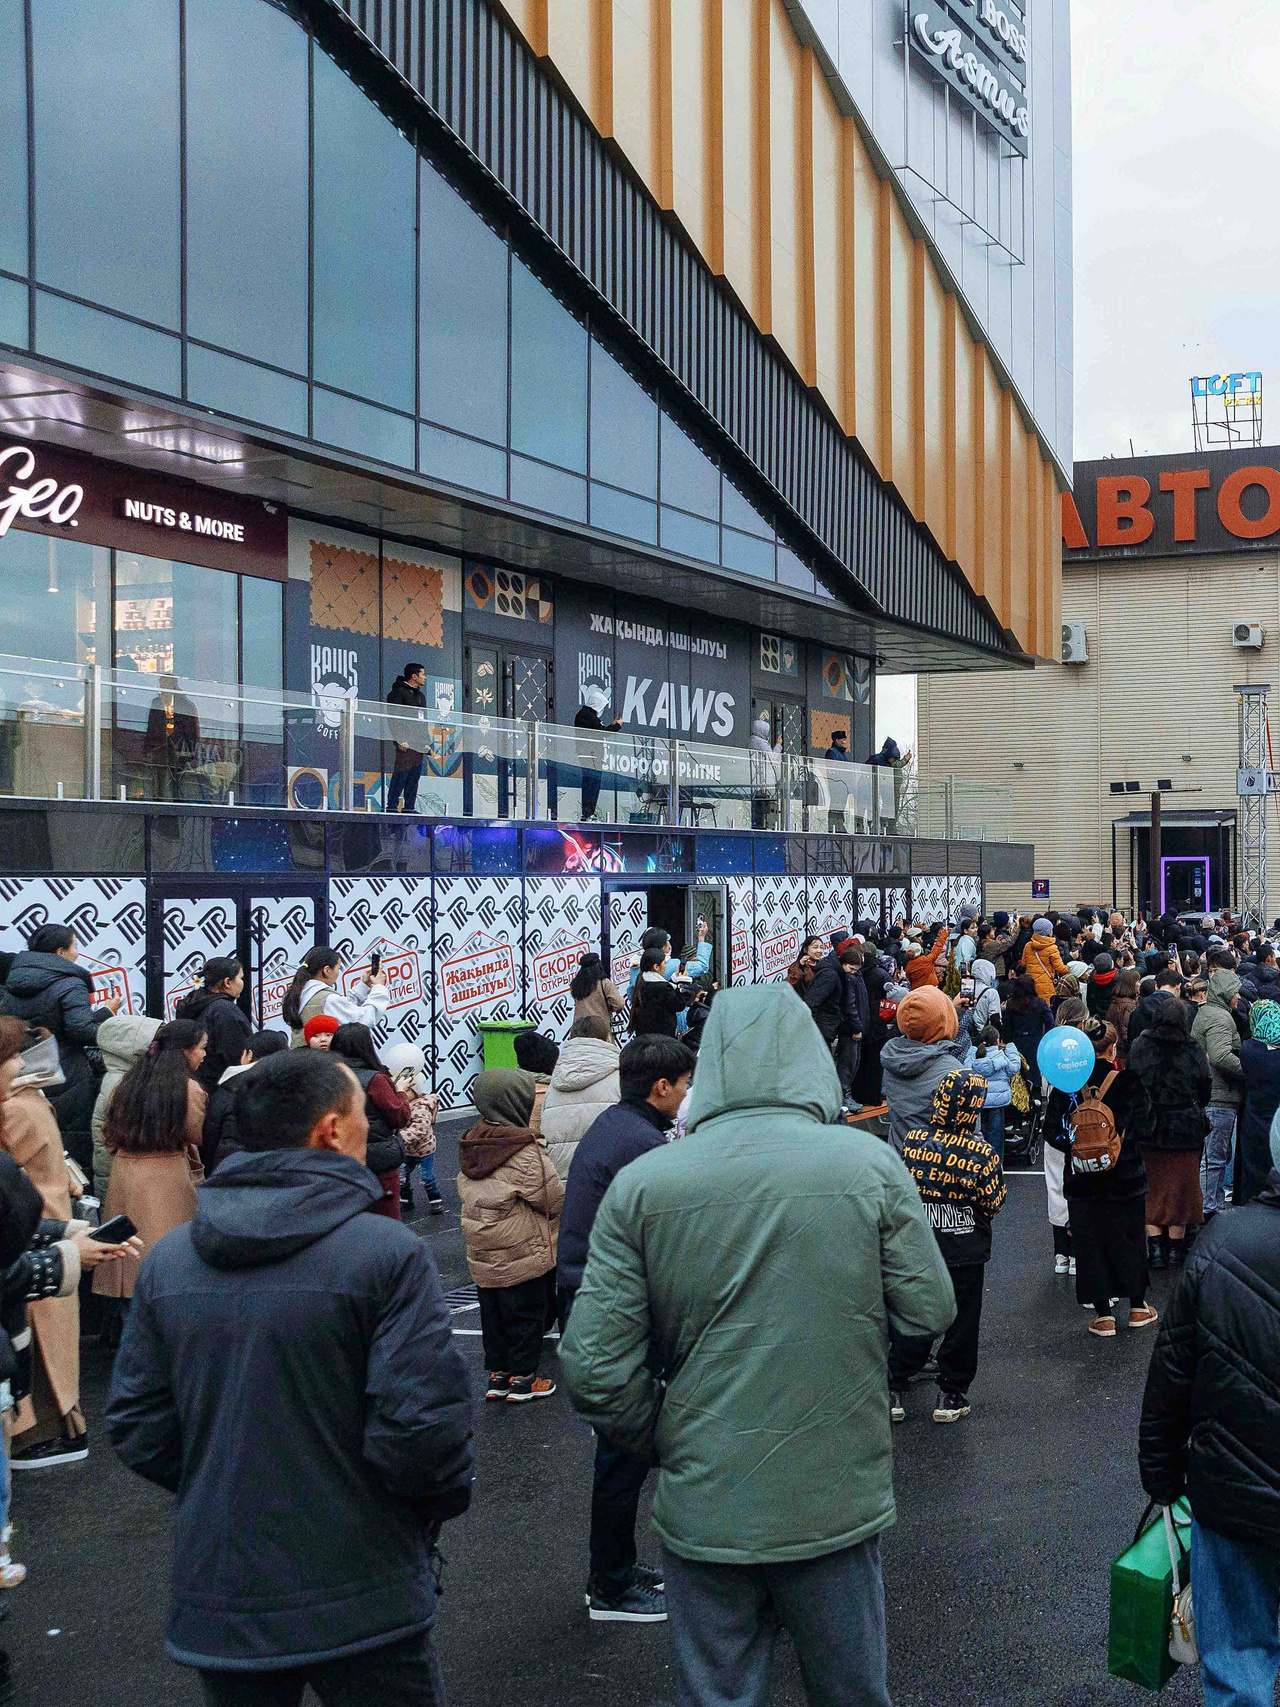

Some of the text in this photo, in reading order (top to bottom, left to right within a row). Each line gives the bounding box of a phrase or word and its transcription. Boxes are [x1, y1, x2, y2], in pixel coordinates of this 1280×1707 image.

[1193, 372, 1262, 396] LOFT
[1225, 397, 1262, 407] PARK
[124, 499, 244, 542] NUTS & MORE
[590, 613, 727, 659] ЖАҚЫНДА АШЫЛУЫ
[622, 675, 735, 737] KAWS
[764, 936, 797, 960] СКОРО
[451, 977, 507, 1003] ашылуы
[946, 1154, 982, 1174] Date
